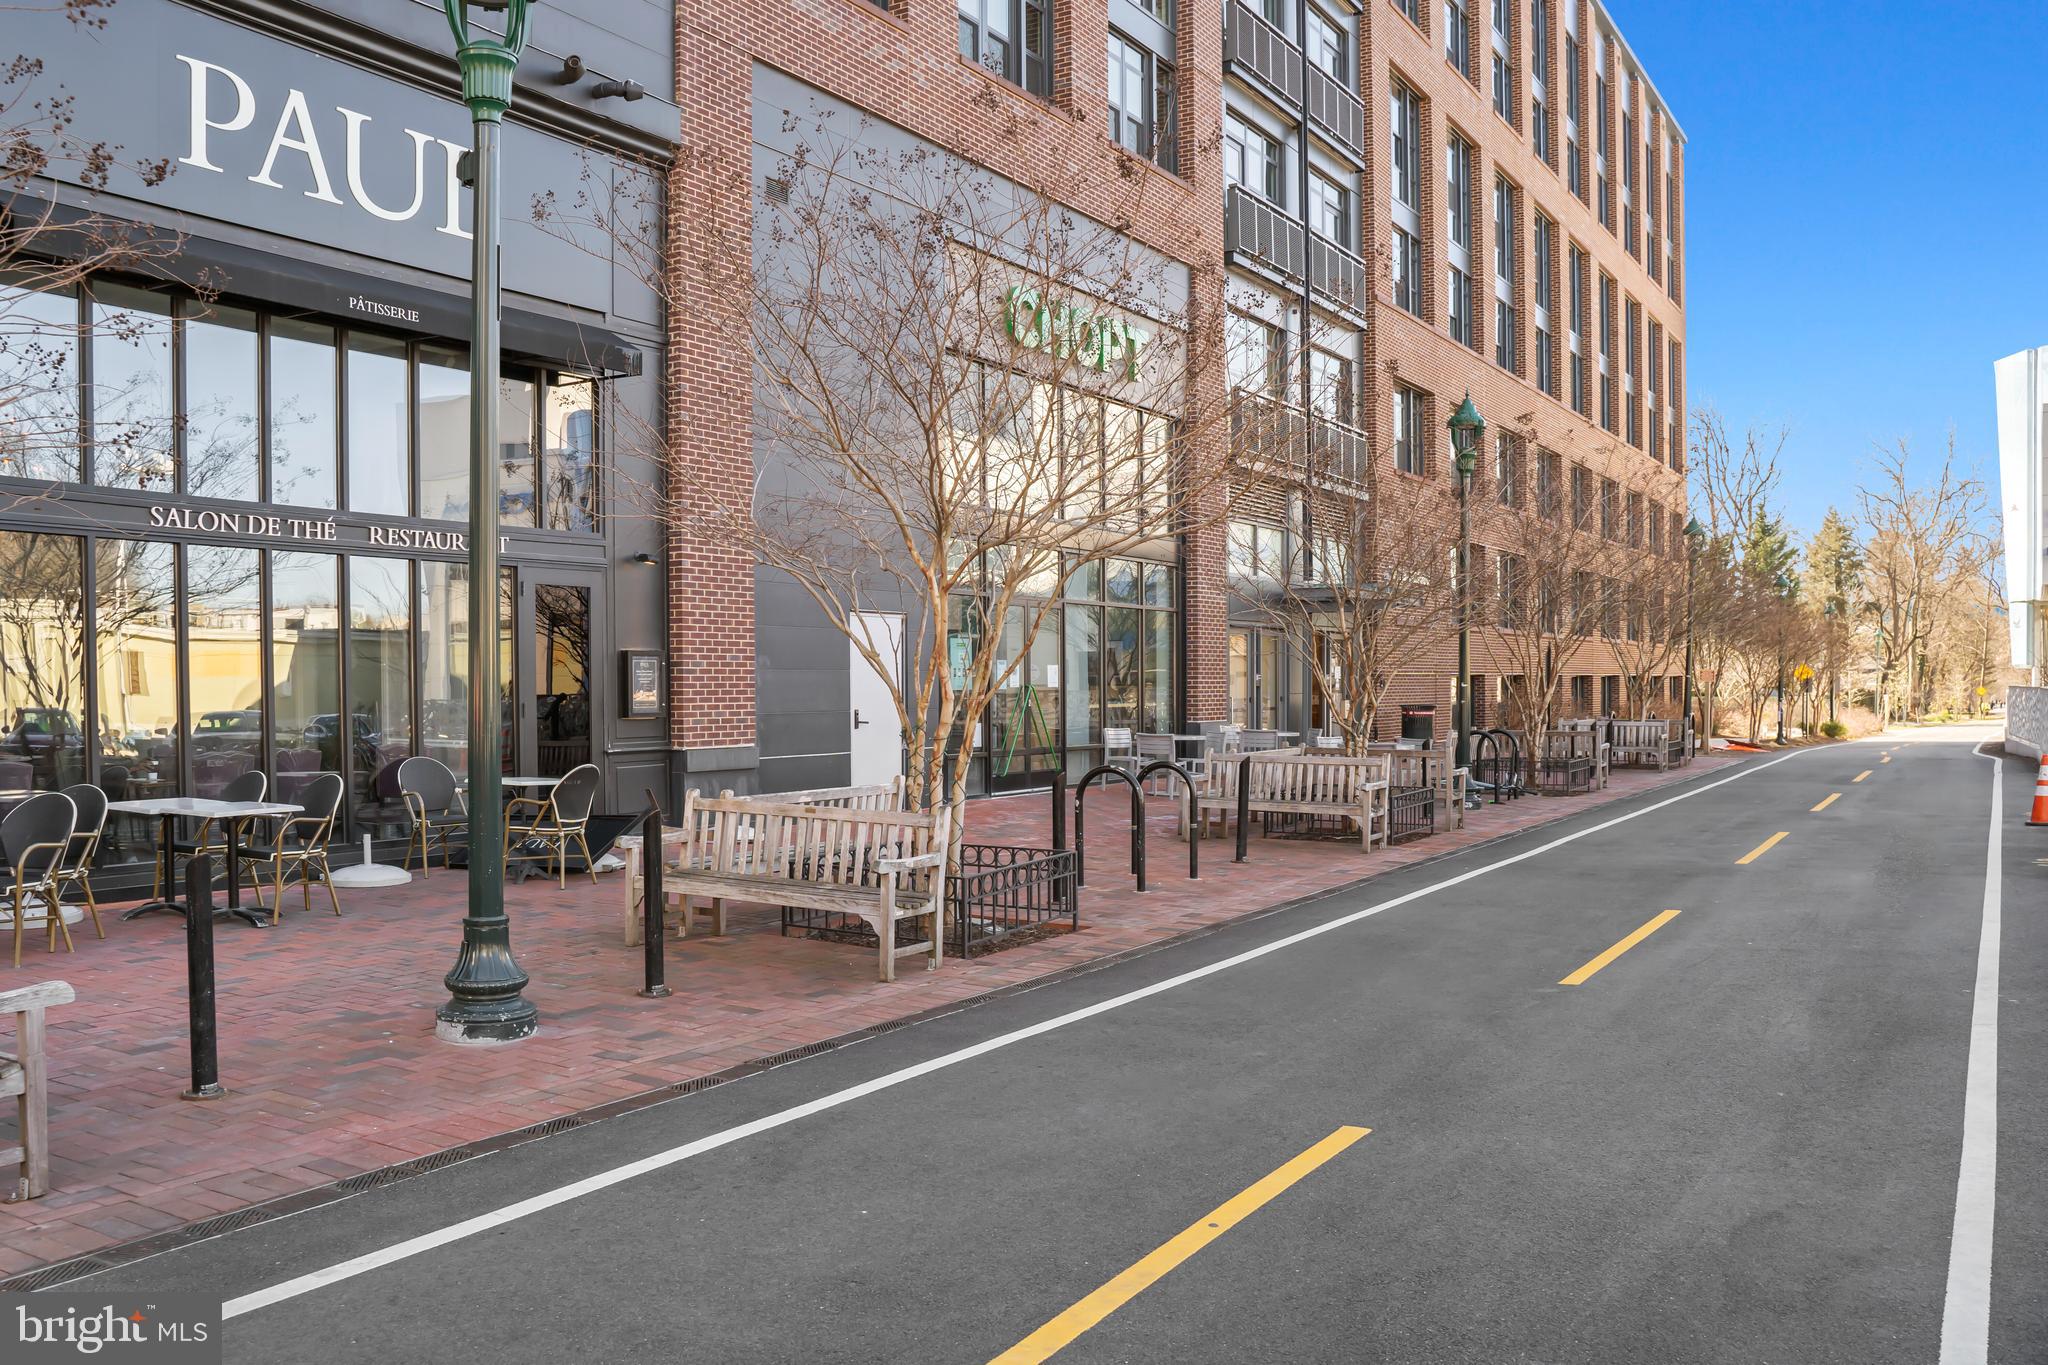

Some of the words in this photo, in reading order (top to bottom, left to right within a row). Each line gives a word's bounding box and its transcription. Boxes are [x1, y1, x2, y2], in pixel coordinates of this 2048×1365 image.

[349, 295, 420, 323] PÂTISSERIE
[150, 506, 241, 534] SALON
[247, 514, 281, 537] DE
[287, 516, 337, 541] THÉ
[369, 526, 510, 554] RESTAURT
